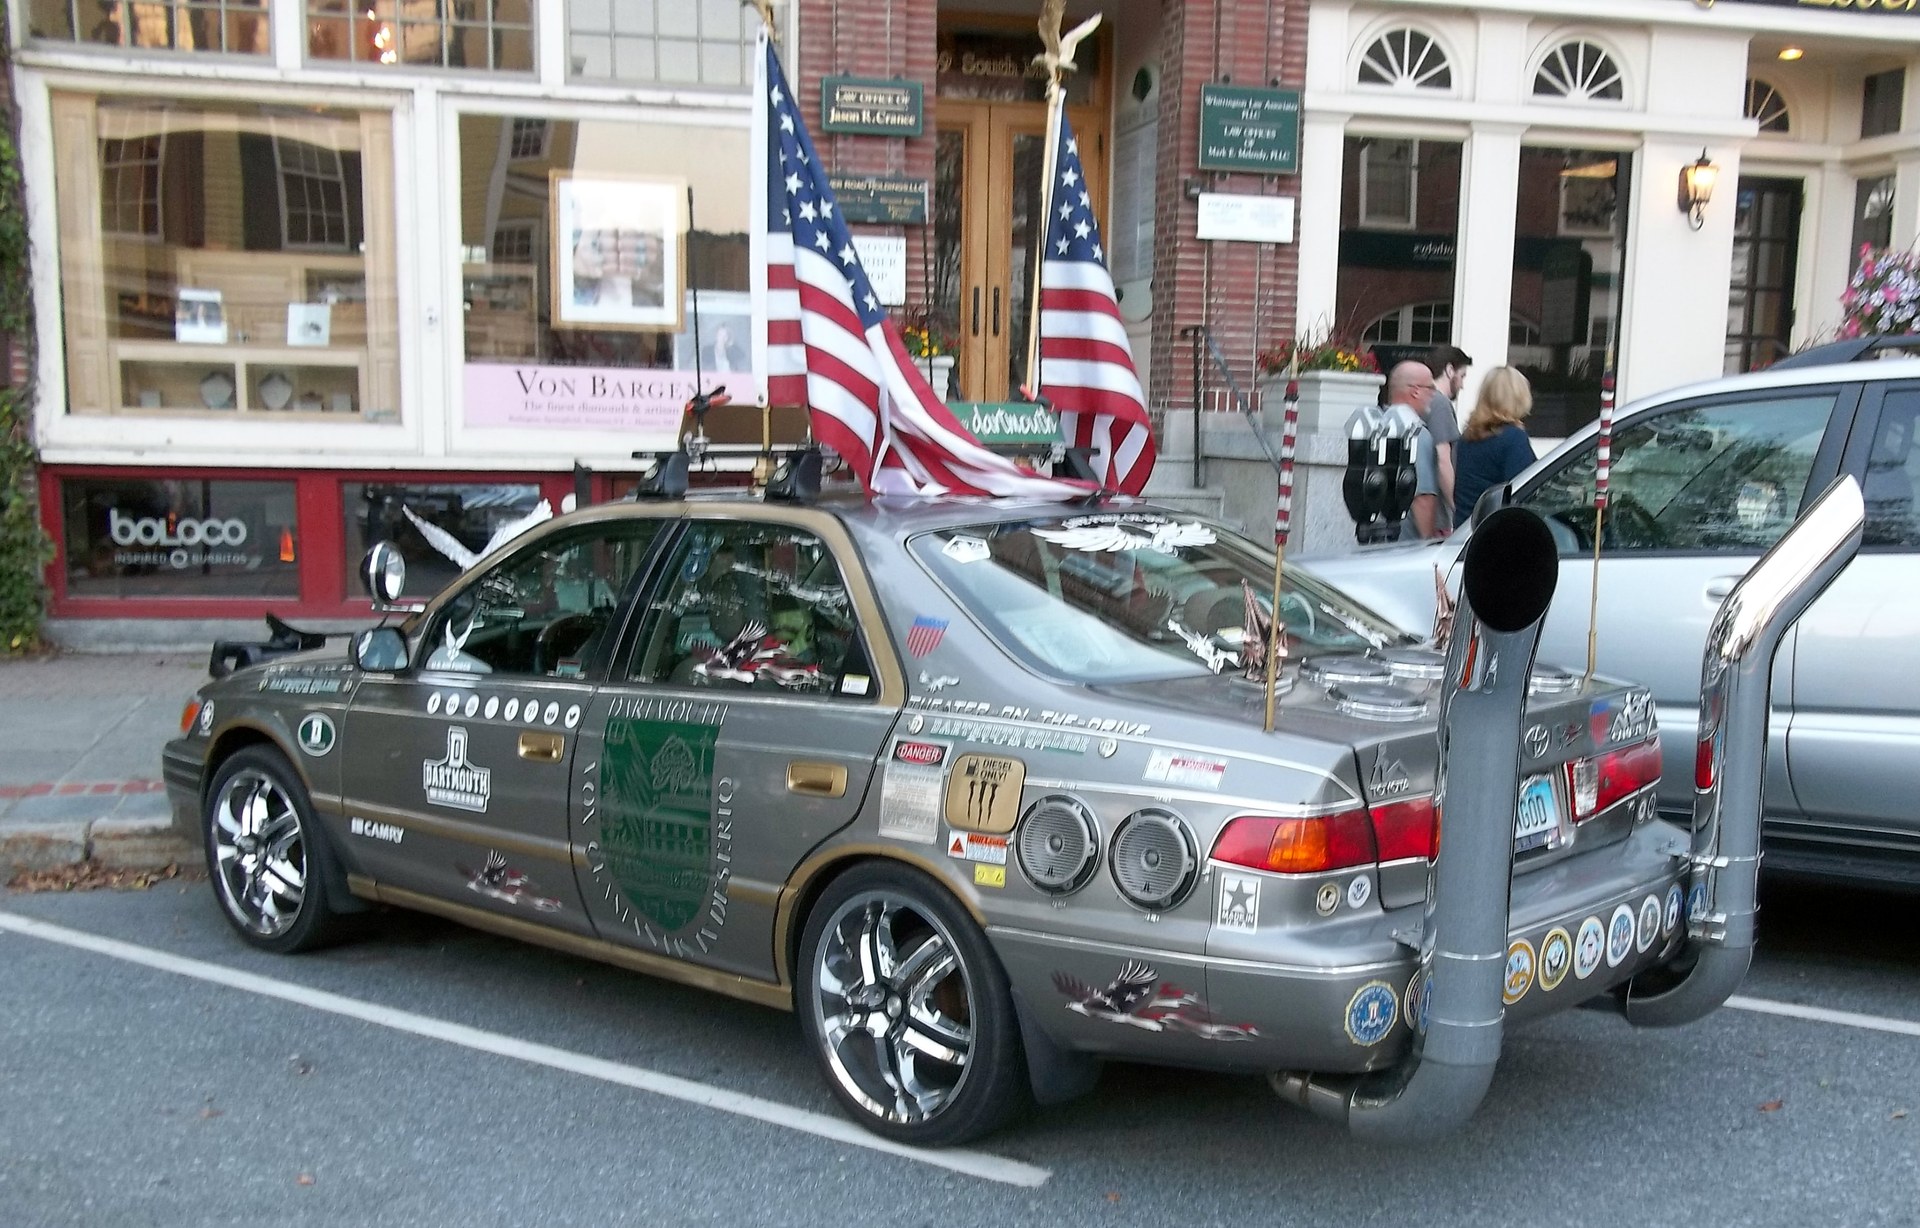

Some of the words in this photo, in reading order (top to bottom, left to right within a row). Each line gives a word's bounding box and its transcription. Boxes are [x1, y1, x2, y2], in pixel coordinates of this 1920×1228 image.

[961, 53, 1018, 77] South
[829, 106, 860, 124] Jason
[516, 370, 576, 396] VON
[523, 400, 543, 412] The
[899, 744, 942, 761] DANGER
[982, 758, 1013, 771] DIESEL
[425, 764, 488, 795] DARTMOUTH
[1370, 778, 1409, 797] TOYOTA
[364, 820, 405, 844] CAMRY
[1221, 909, 1244, 921] MADE
[1245, 912, 1255, 924] IN
